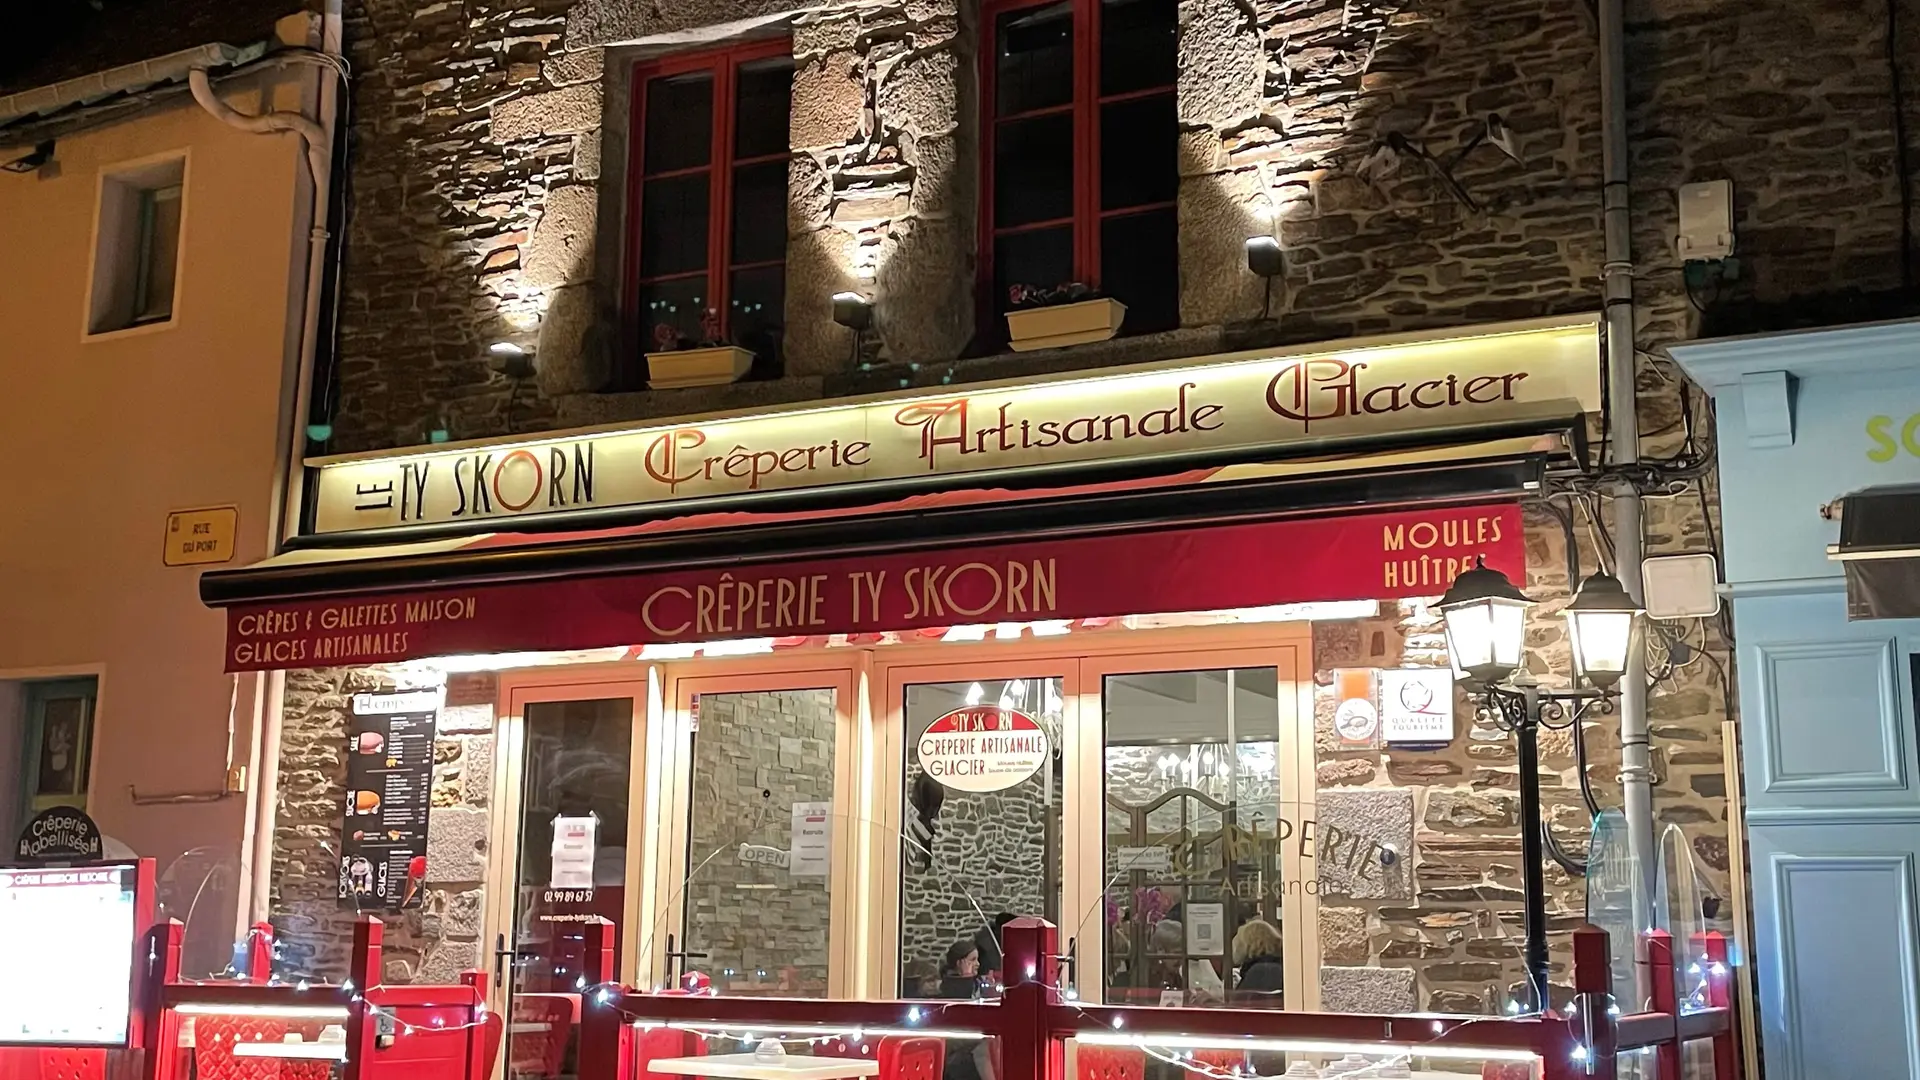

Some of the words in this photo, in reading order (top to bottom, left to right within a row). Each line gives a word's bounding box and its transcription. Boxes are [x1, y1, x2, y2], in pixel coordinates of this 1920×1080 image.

[645, 429, 871, 494] Crêperie
[894, 382, 1224, 470] Artisanale
[1265, 359, 1529, 433] Glacier
[355, 480, 393, 510] LE
[400, 461, 430, 520] TY
[452, 442, 593, 516] SKORN
[193, 522, 212, 535] RUE
[1384, 516, 1501, 551] MOULES
[196, 540, 218, 552] PORT
[1384, 554, 1486, 588] HUÎTRE
[641, 572, 828, 636] CRÊPERIE
[848, 570, 886, 623] TY
[904, 558, 1057, 619] SKORN
[238, 610, 299, 636] CRÊPES
[321, 603, 397, 629] GALETTES
[405, 597, 476, 623] MAISON
[235, 639, 306, 664] GLACES
[314, 632, 409, 659] ARTISANALES
[958, 713, 970, 731] TY
[981, 736, 1042, 754] ARTISANALE
[930, 759, 985, 776] GLACIER
[32, 814, 88, 837] Crêperie
[744, 849, 785, 865] OPEN
[544, 890, 553, 902] 02
[554, 890, 564, 902] 99
[564, 890, 575, 902] 89
